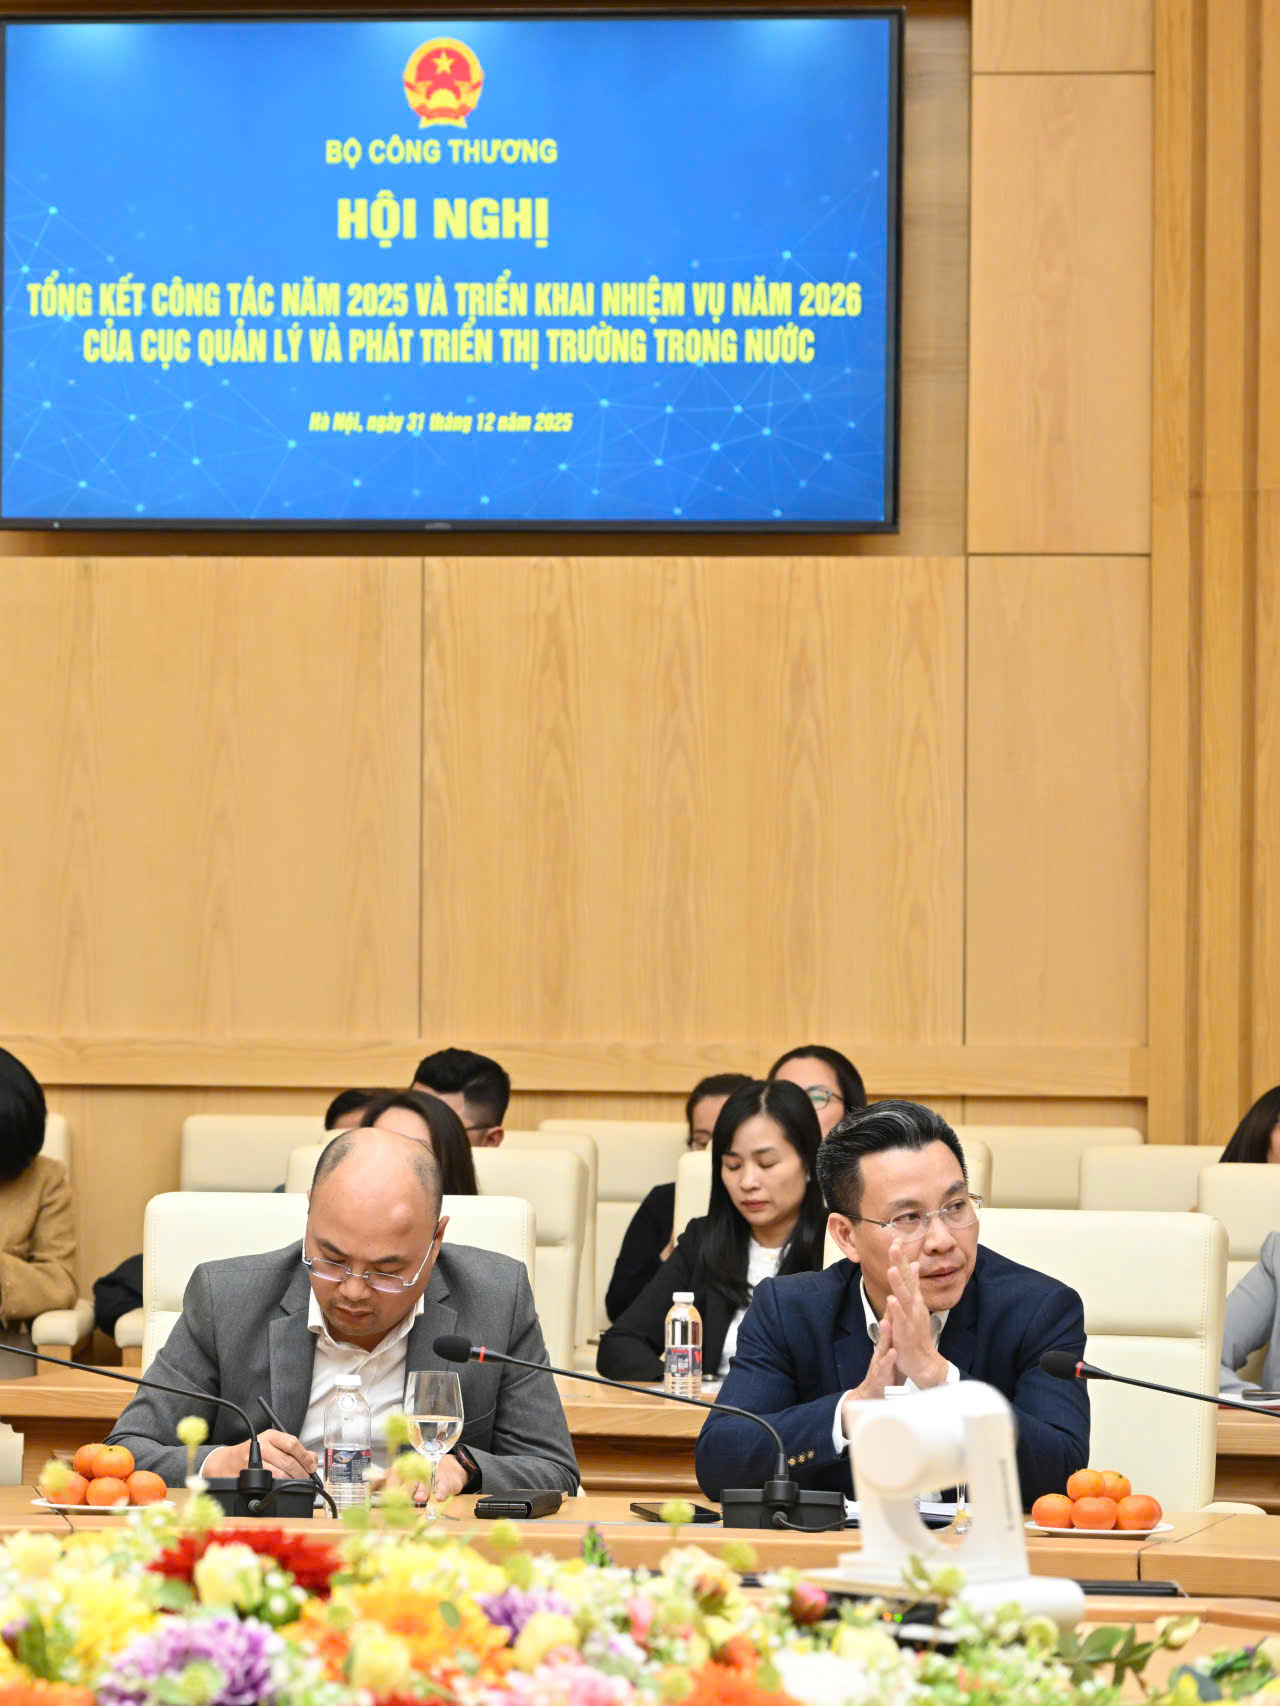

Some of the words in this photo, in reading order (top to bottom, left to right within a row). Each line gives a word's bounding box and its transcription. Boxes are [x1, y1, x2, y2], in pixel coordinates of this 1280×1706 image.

[327, 139, 361, 168] BỘ
[370, 135, 440, 162] CÔNG
[449, 140, 556, 162] THƯƠNG
[339, 189, 416, 248] HỘI
[435, 199, 547, 247] NGHỊ
[28, 270, 91, 315] TỔNG
[100, 273, 145, 315] KẾT
[153, 277, 219, 316] CÔNG
[228, 278, 273, 315] TÁC
[283, 278, 339, 315] NĂM
[348, 284, 408, 315] 2025
[416, 277, 447, 315] VÀ
[456, 269, 526, 315] TRIỂN
[536, 283, 594, 315] KHAI
[602, 276, 684, 323] NHIỆM
[693, 283, 724, 322] VỤ
[733, 277, 791, 315] NĂM
[800, 283, 860, 315] 2026
[85, 319, 132, 362] CỦA
[142, 330, 190, 368] CỤC
[199, 319, 266, 365] QUẢN
[275, 323, 302, 361] LÝ
[310, 323, 341, 361] VÀ
[350, 323, 413, 361] PHÁT
[421, 316, 492, 362] TRIỂN
[501, 330, 538, 368] THỊ
[547, 322, 646, 362] TRƯỜNG
[654, 329, 736, 362] TRONG
[746, 323, 814, 362] NƯỚC
[310, 413, 329, 430] Hà
[334, 414, 362, 433] Nội,
[368, 414, 403, 432] ngày
[408, 413, 424, 430] 31
[430, 414, 472, 432] tháng
[477, 413, 496, 431] 12
[498, 413, 531, 431] năm
[535, 413, 572, 431] 2025
